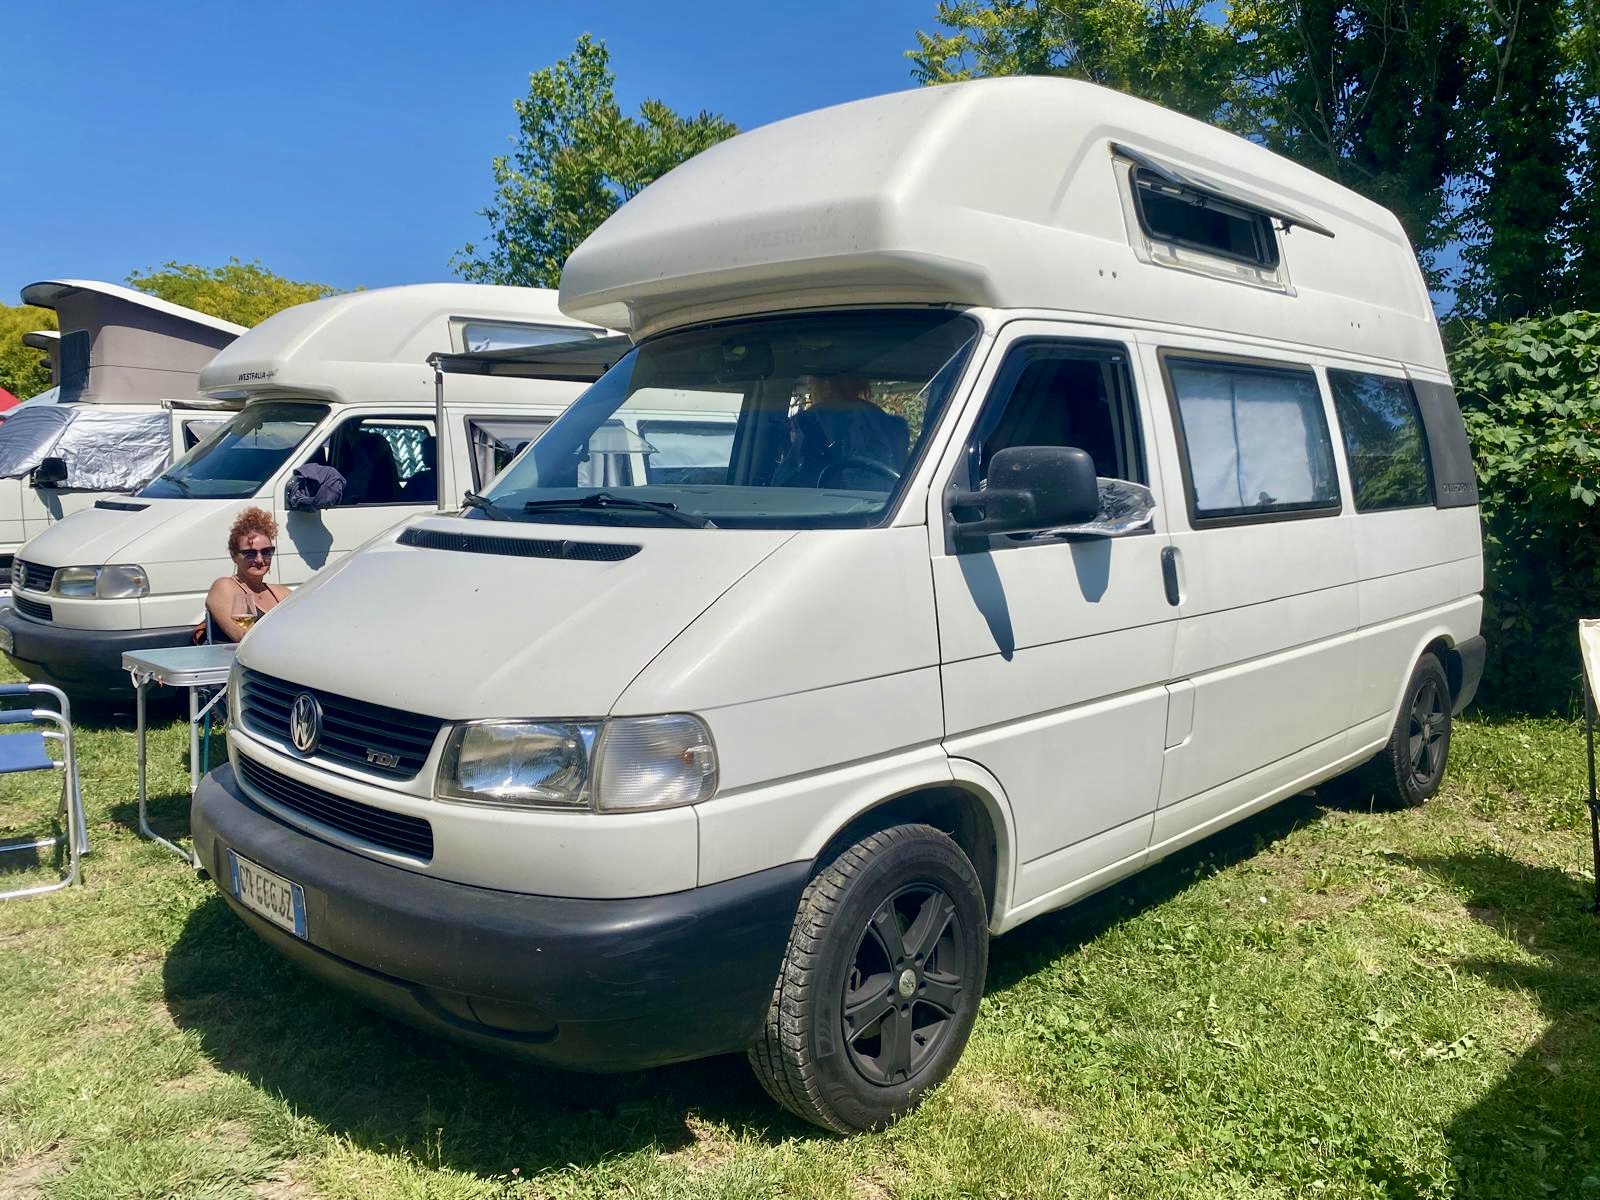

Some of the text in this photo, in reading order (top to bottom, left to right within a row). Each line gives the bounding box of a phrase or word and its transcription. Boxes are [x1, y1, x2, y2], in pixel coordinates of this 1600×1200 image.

[744, 223, 840, 251] WESTFALIA
[238, 371, 265, 381] WESTFALIA
[366, 748, 400, 768] TDI
